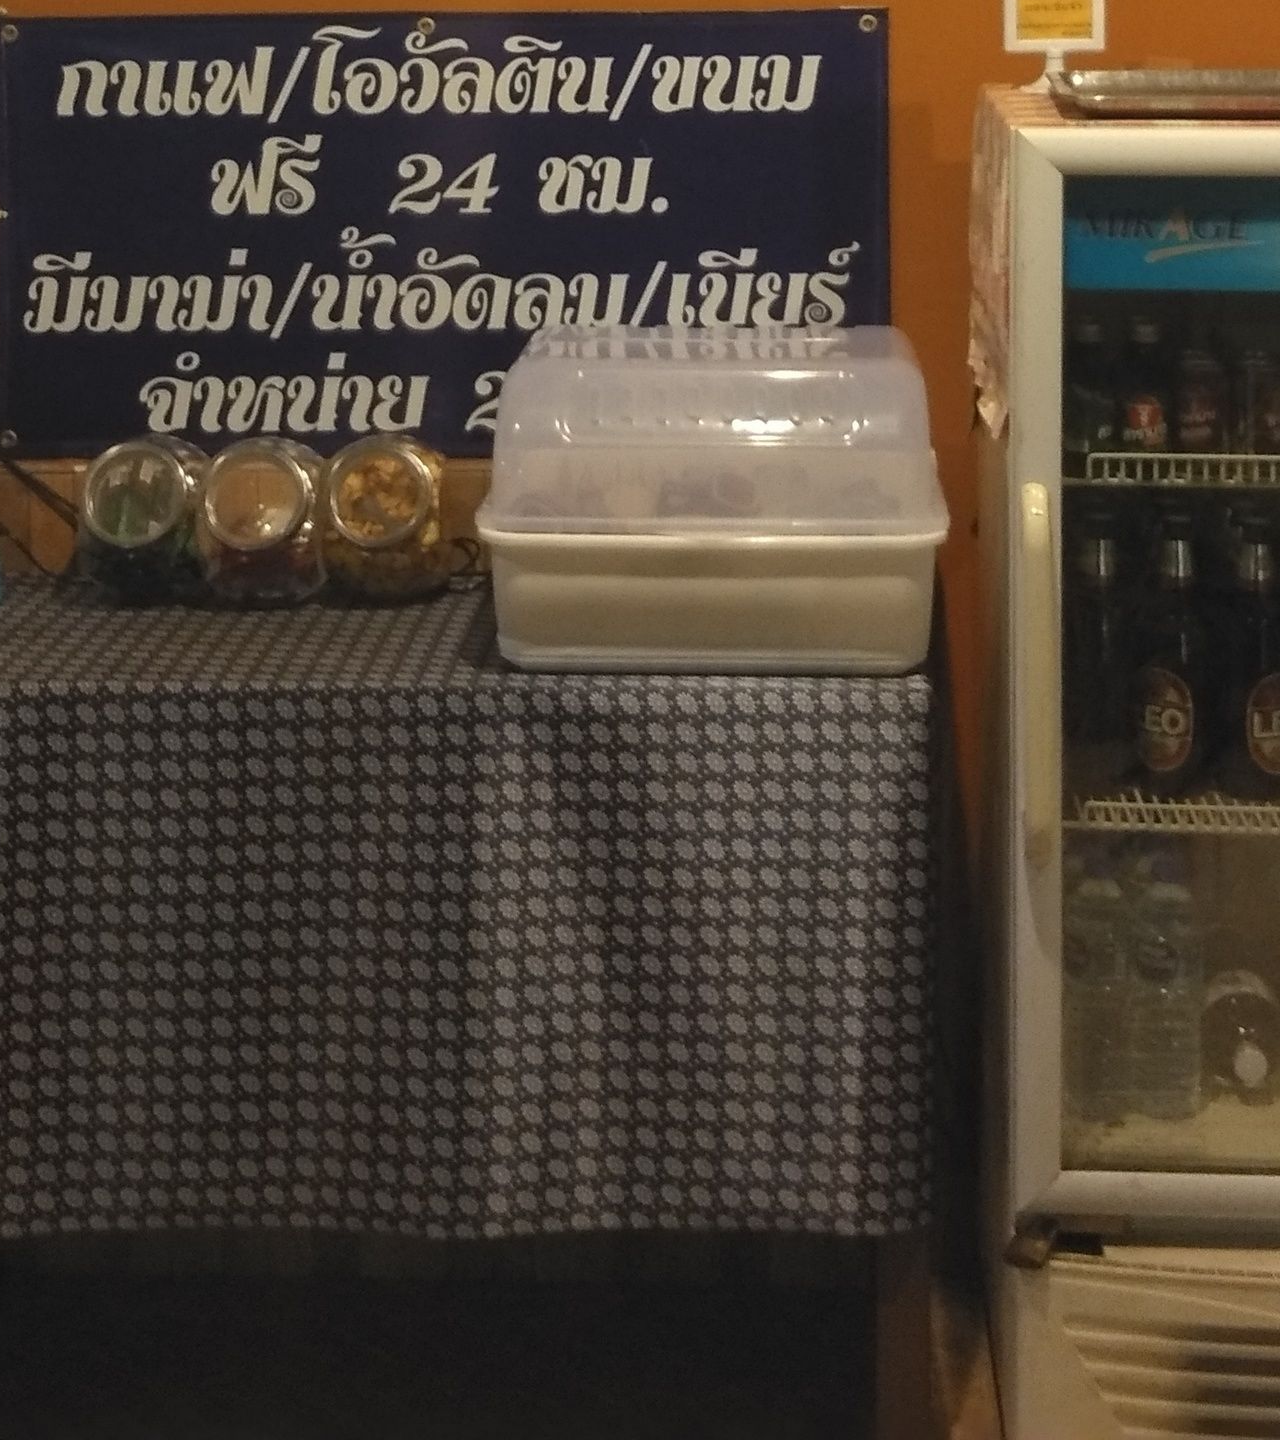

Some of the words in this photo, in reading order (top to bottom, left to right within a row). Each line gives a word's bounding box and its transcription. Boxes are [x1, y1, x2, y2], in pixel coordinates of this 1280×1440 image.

[56, 25, 822, 123] กาแฟ/โอวัลติน/ขนม
[209, 134, 323, 216] ฟรี
[387, 153, 500, 215] 24
[537, 154, 670, 215] ชม.
[138, 351, 430, 433] จำหน่าย
